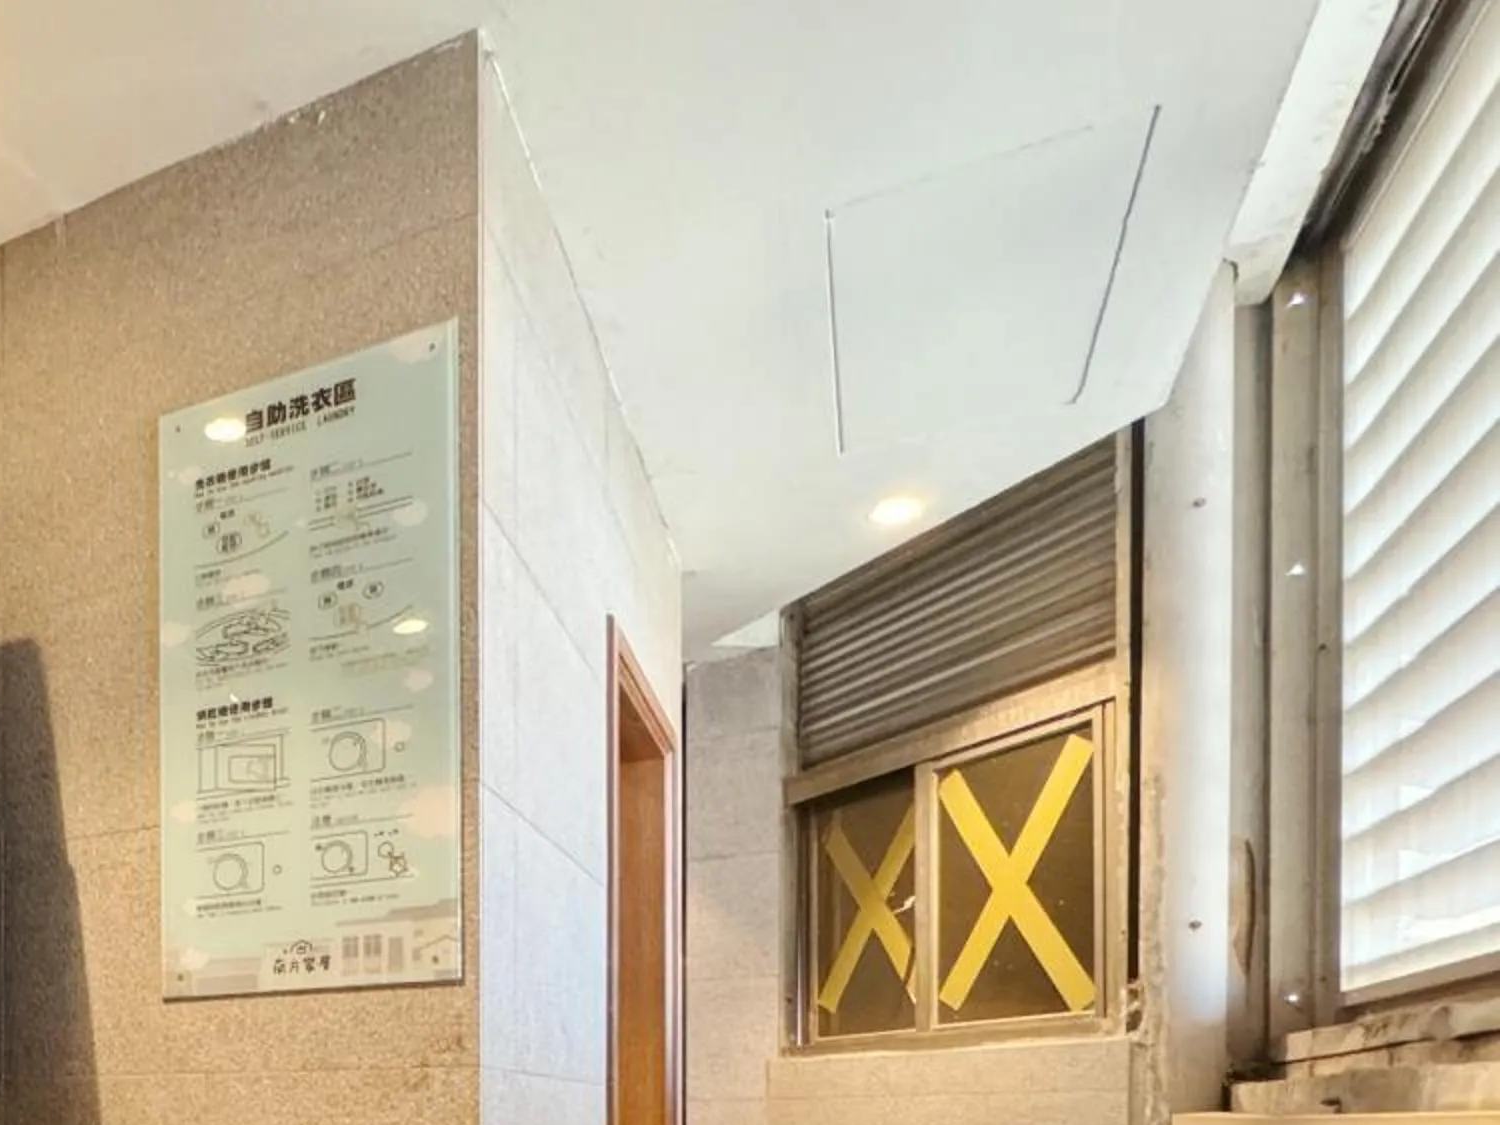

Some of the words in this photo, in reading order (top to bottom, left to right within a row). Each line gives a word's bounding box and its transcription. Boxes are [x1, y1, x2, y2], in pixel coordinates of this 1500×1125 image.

[245, 377, 356, 434] 自助洗衣區
